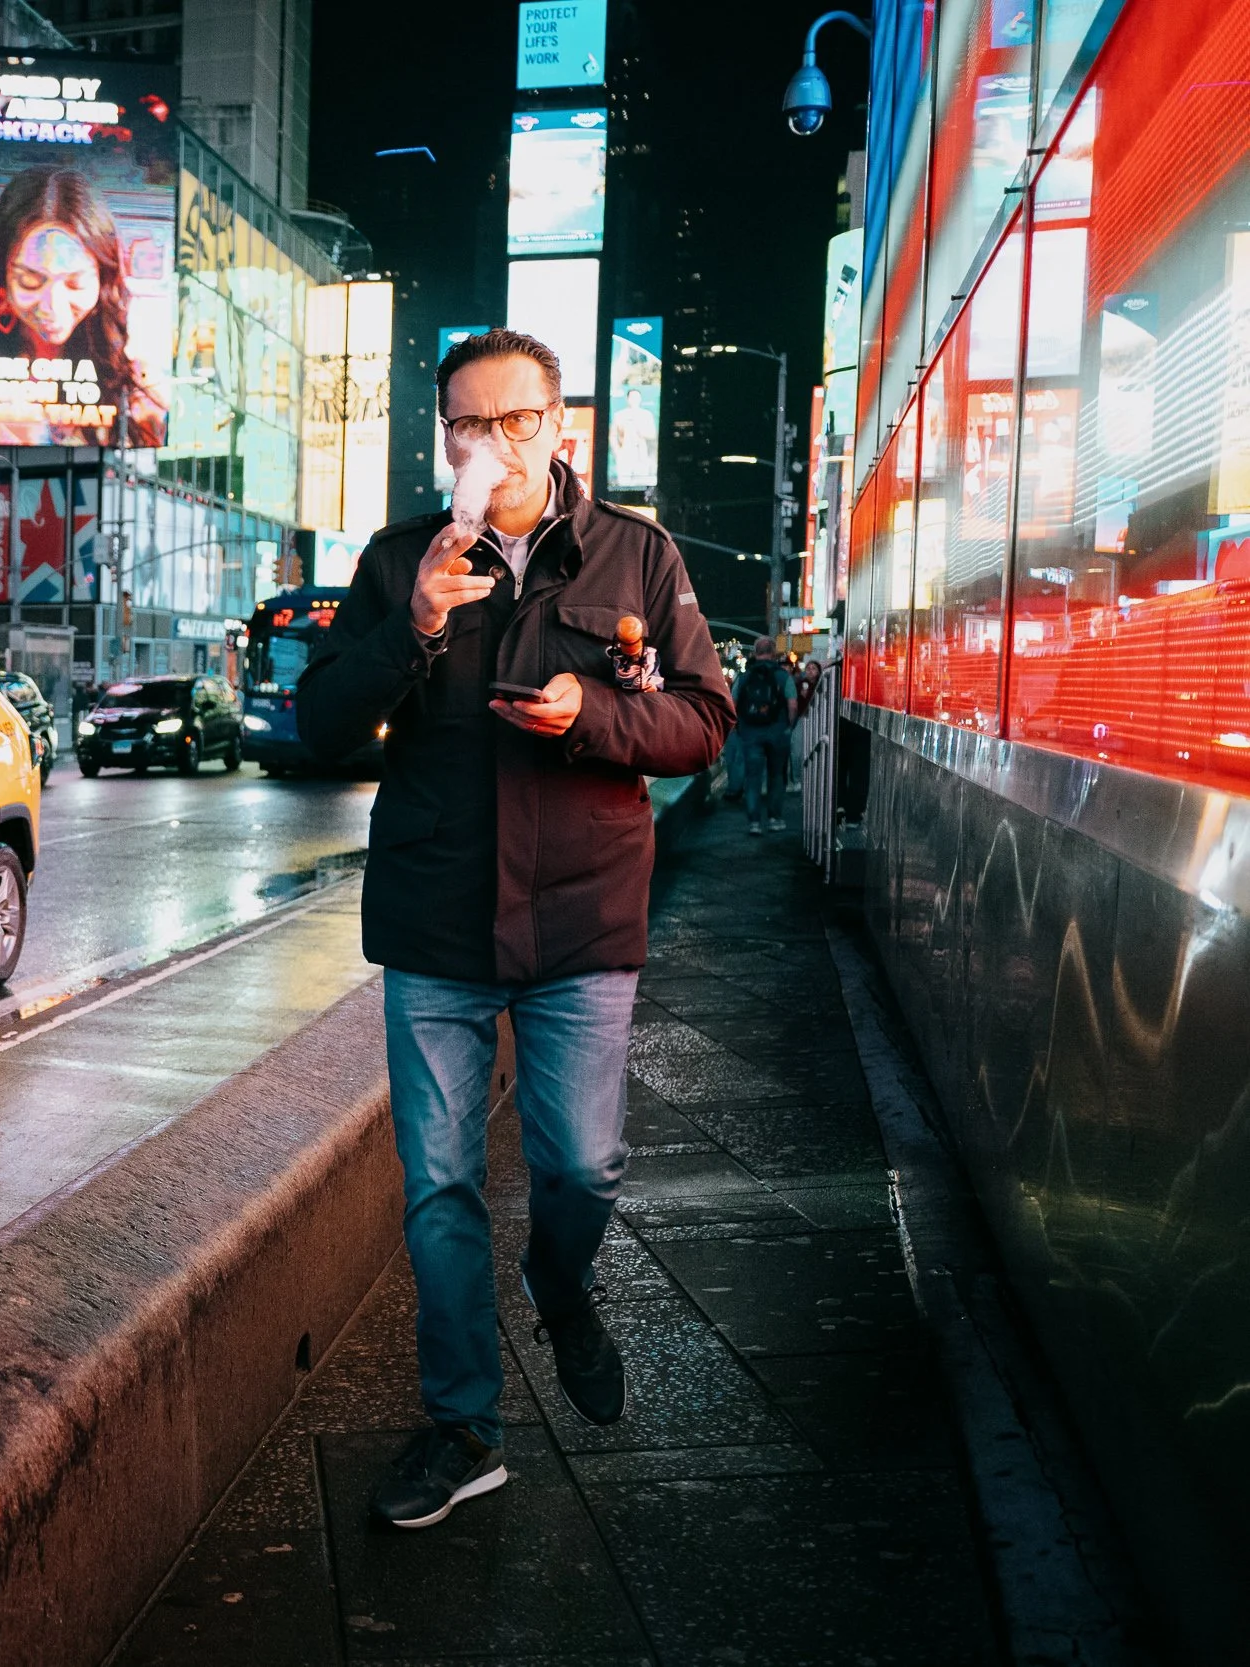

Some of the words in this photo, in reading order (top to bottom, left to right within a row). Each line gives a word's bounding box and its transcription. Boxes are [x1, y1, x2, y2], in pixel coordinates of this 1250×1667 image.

[526, 7, 578, 20] PROTECT
[526, 21, 557, 34] YOUR
[525, 35, 558, 48] LIFE'S
[524, 52, 559, 65] WORK
[74, 359, 98, 381] A
[62, 382, 101, 404] TO
[44, 404, 117, 428] THAT
